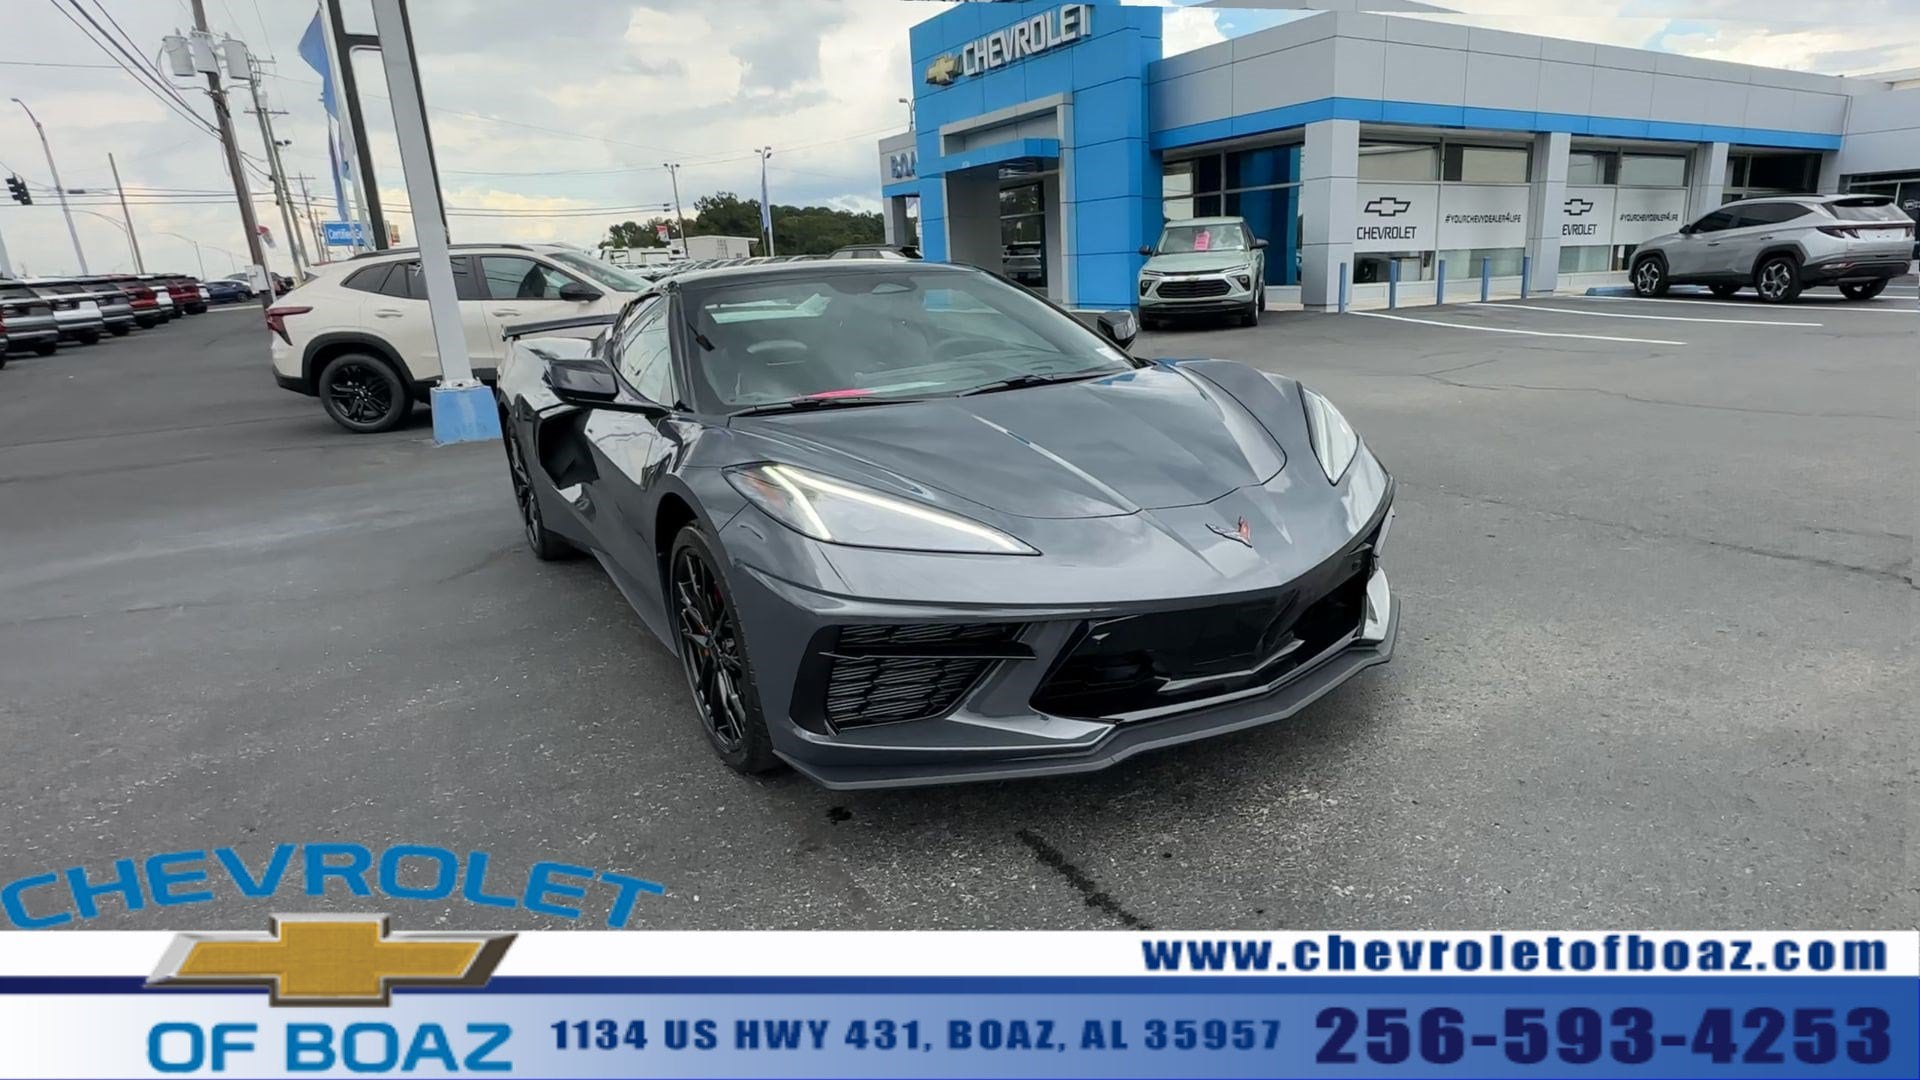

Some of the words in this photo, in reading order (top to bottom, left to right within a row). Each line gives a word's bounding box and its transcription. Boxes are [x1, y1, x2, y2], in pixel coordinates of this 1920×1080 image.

[962, 3, 1093, 77] CHEVROLET
[1356, 226, 1416, 240] CHEVROLET
[1561, 223, 1597, 236] EVROLET
